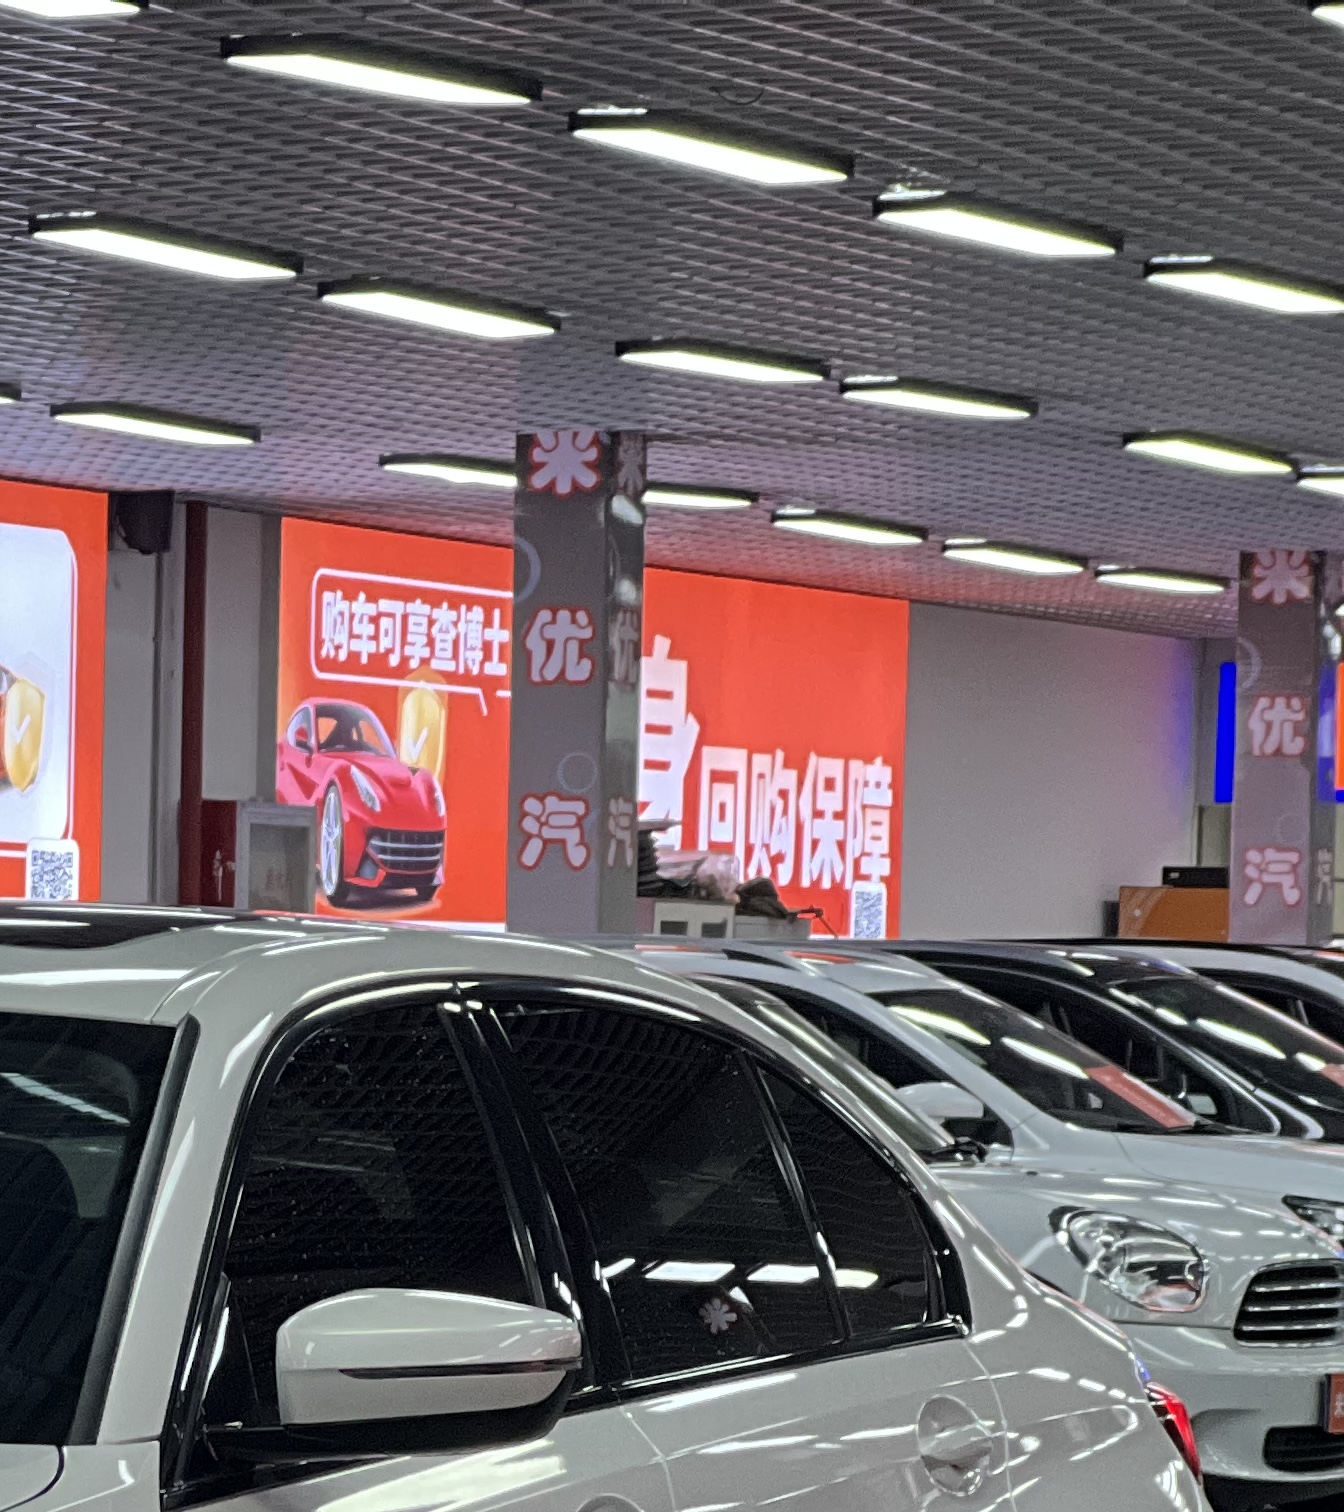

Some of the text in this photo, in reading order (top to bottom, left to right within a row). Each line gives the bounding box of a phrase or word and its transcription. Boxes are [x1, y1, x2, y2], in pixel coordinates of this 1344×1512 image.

[321, 590, 510, 676] 购车可享查博士
